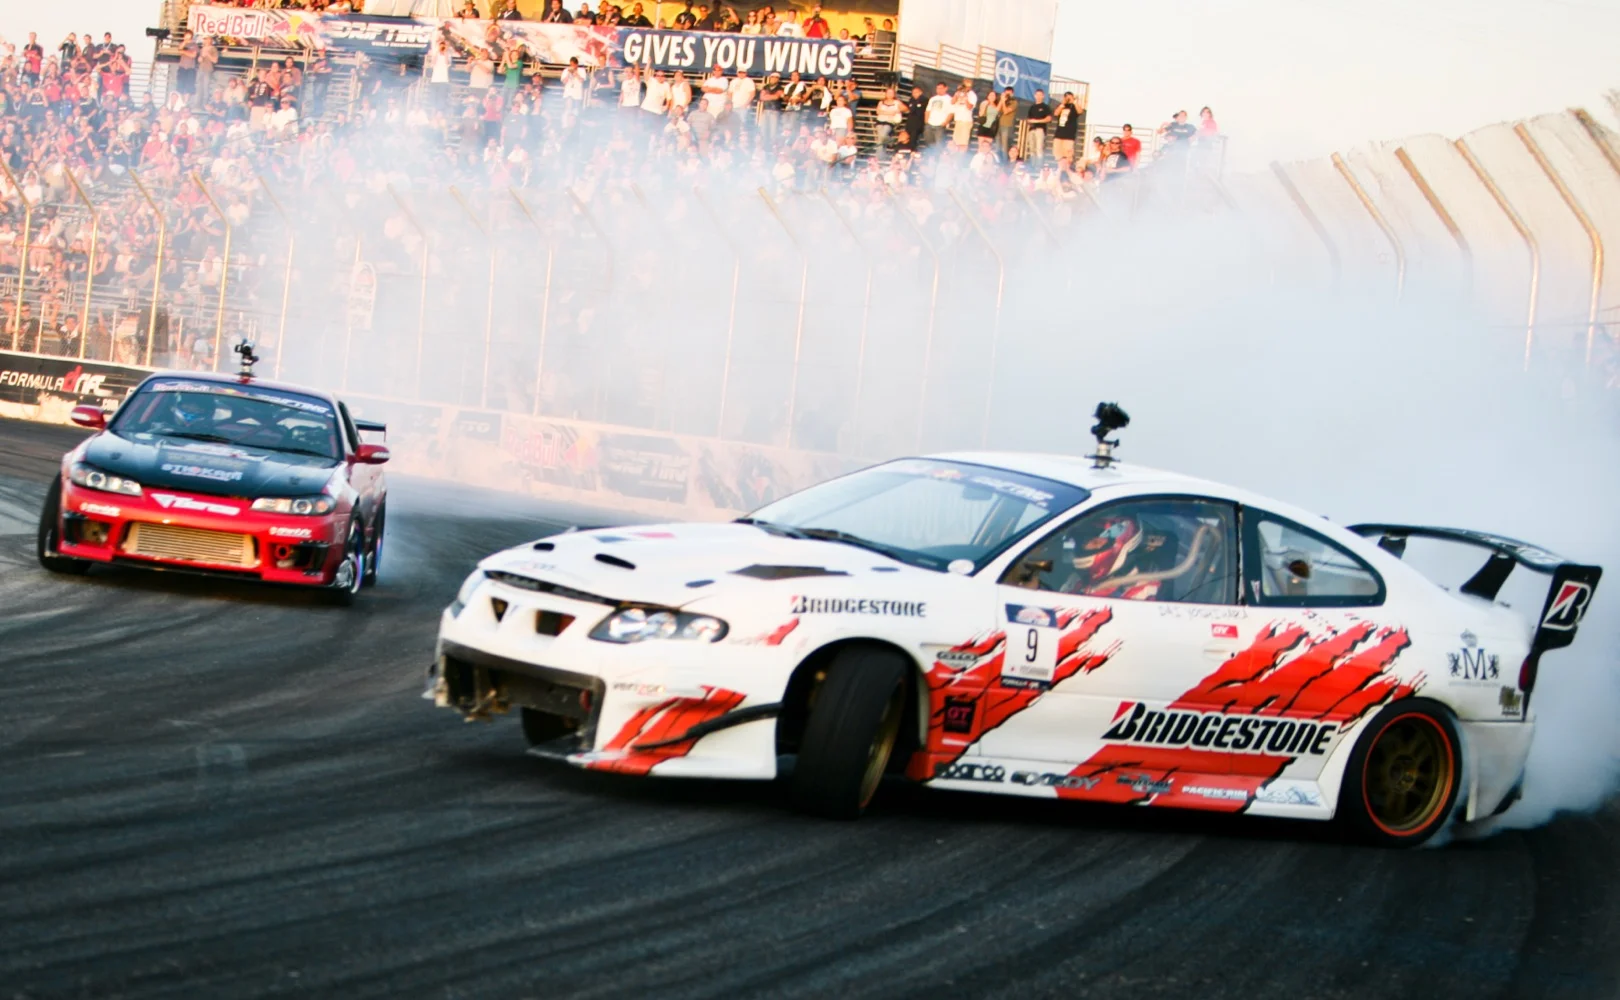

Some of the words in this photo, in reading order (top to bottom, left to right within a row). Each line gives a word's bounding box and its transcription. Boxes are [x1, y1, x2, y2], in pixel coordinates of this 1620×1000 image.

[196, 13, 229, 34] Red
[231, 15, 266, 37] Bull
[623, 33, 695, 67] GIVES
[702, 37, 756, 70] YOU
[763, 40, 854, 76] WINGS
[0, 371, 64, 391] FORMULA
[791, 595, 926, 618] BRIDGESTONE
[1025, 628, 1038, 662] 9
[1459, 648, 1487, 681] M
[1101, 701, 1338, 755] BRIDGESTONE
